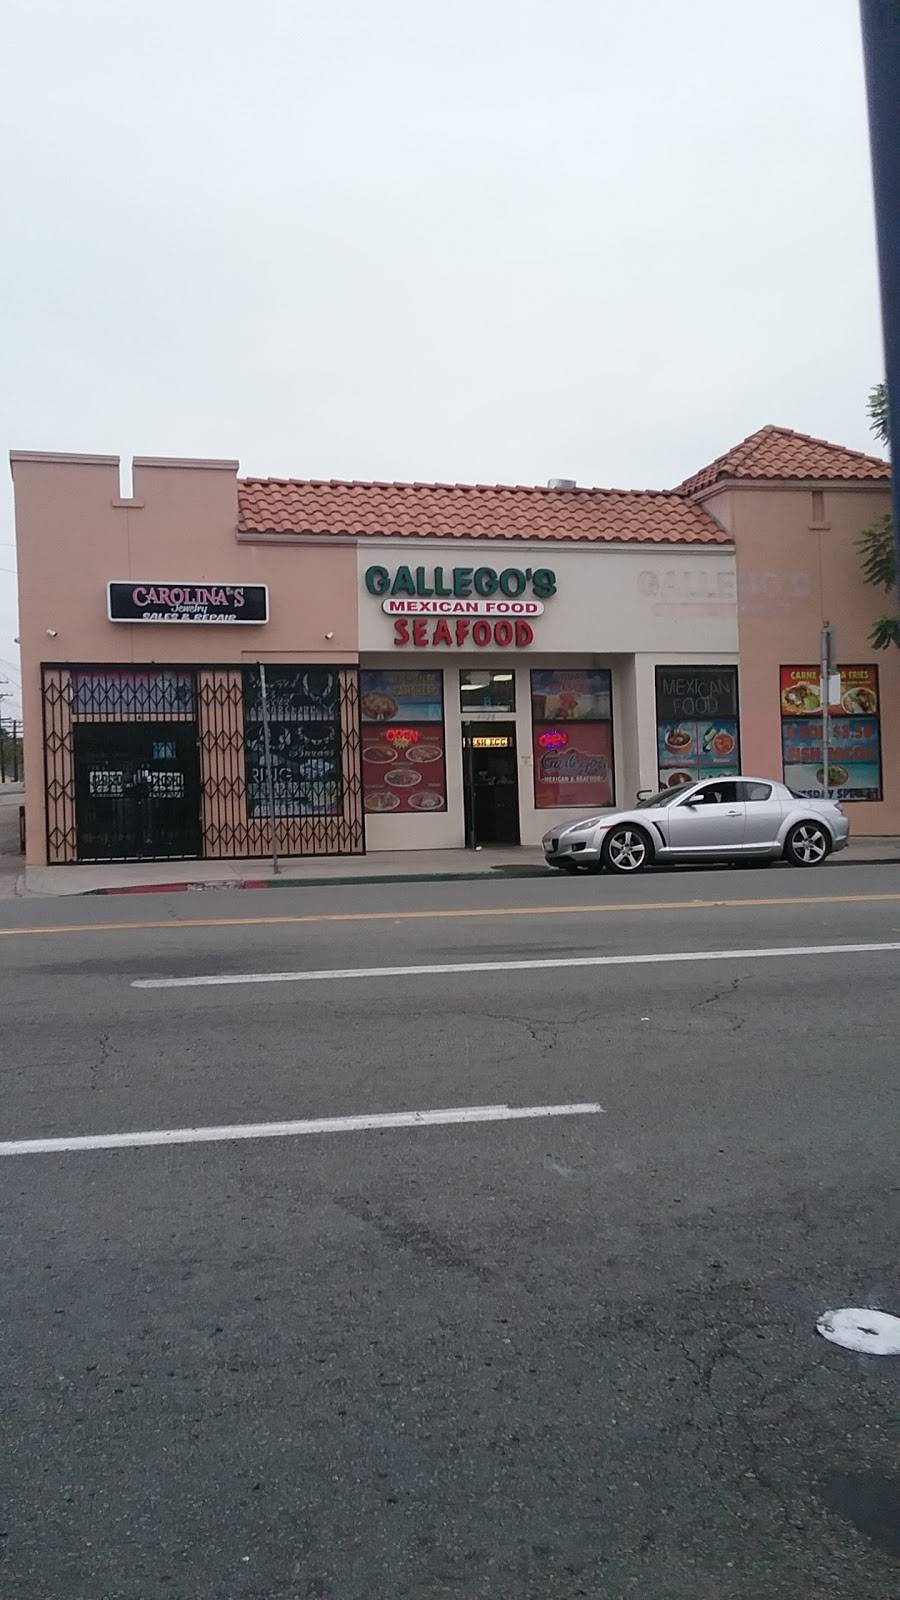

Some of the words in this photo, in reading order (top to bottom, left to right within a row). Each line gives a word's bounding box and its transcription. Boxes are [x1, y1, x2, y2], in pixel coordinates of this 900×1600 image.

[365, 565, 557, 599] GALLEGO'S
[132, 587, 246, 608] CAROLINA'S
[389, 601, 479, 613] MEXICAN
[486, 602, 539, 613] FOOD
[142, 612, 179, 622] SALES
[193, 614, 238, 623] REPAIR
[393, 618, 535, 648] SEAFOOD
[662, 679, 731, 698] MEXICAN
[671, 697, 719, 715] FOOD
[386, 728, 419, 742] OPEN
